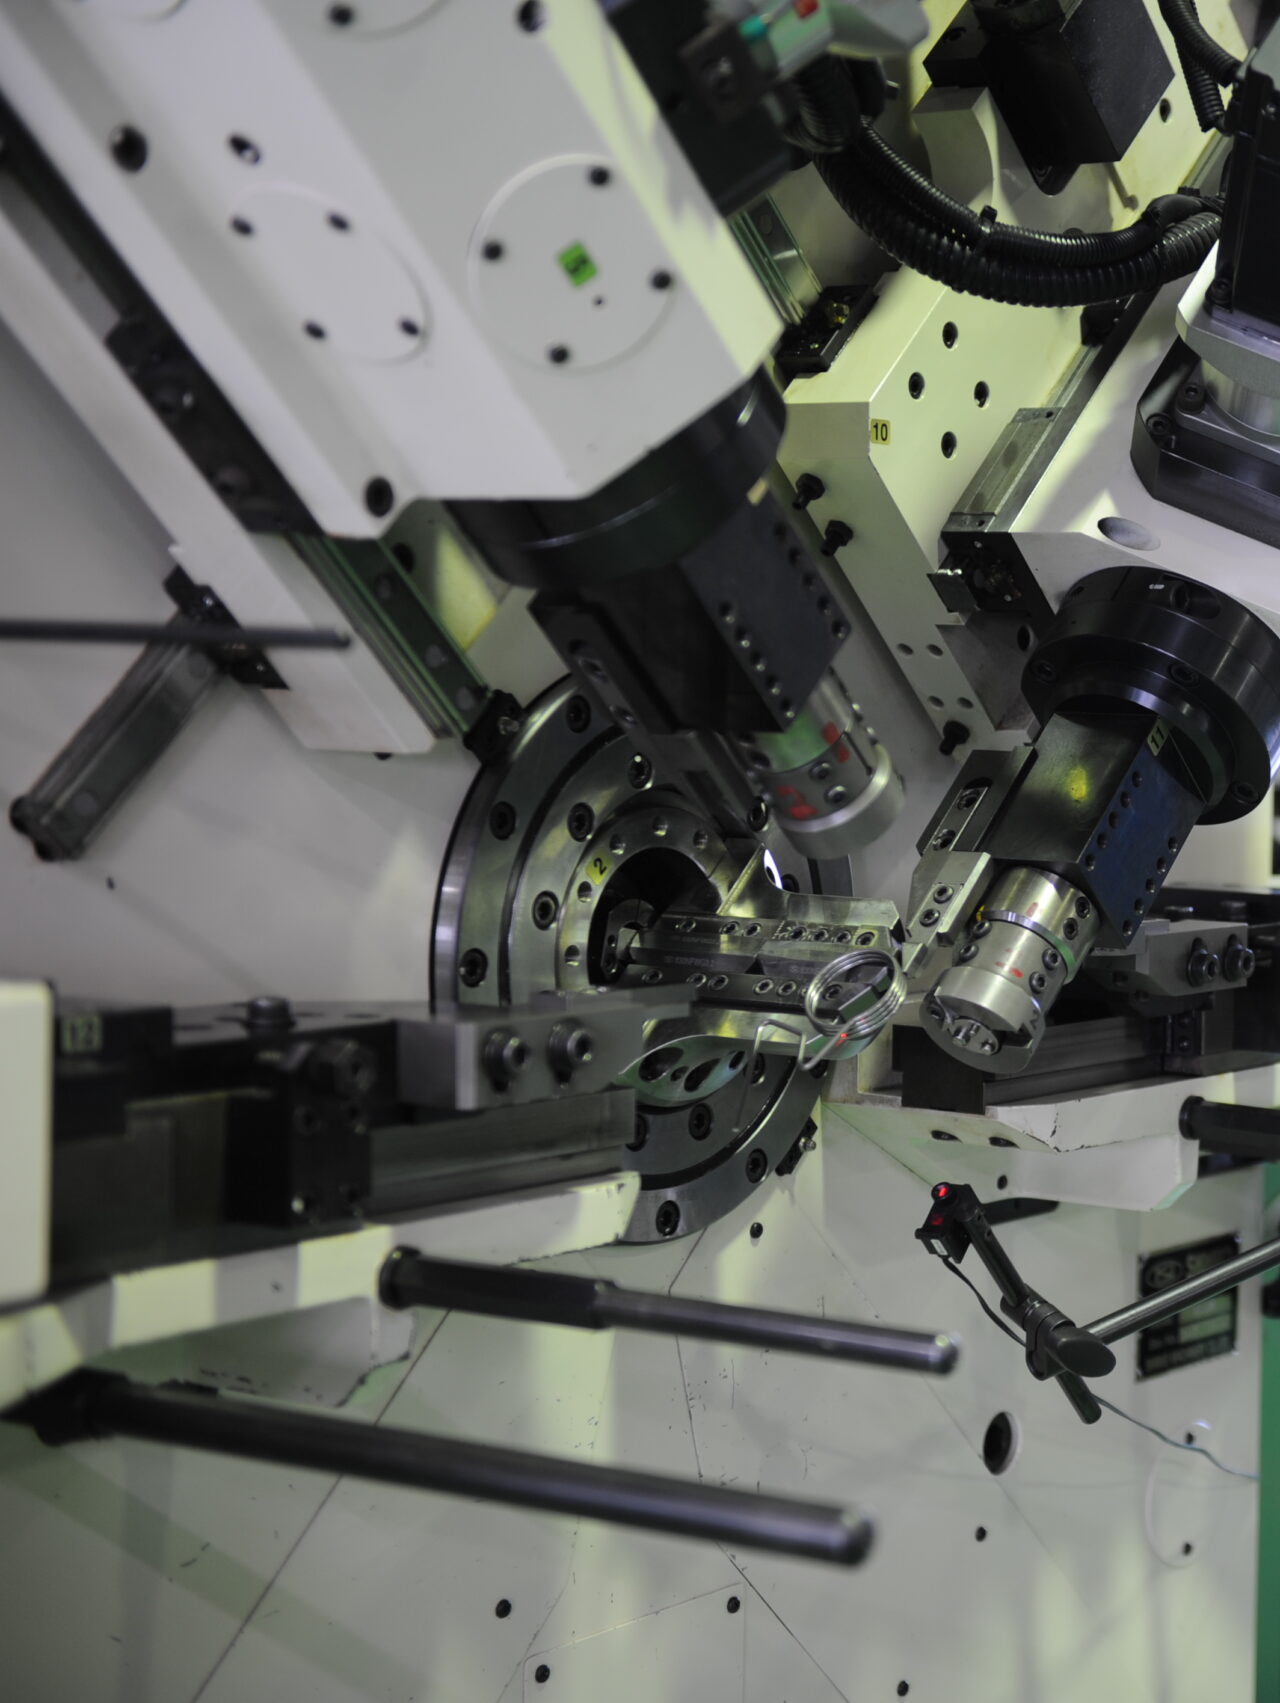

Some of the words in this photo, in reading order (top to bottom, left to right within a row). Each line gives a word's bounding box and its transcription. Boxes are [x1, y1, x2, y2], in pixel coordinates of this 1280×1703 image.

[873, 422, 888, 441] 10
[1151, 726, 1165, 749] 11
[593, 857, 608, 875] 2
